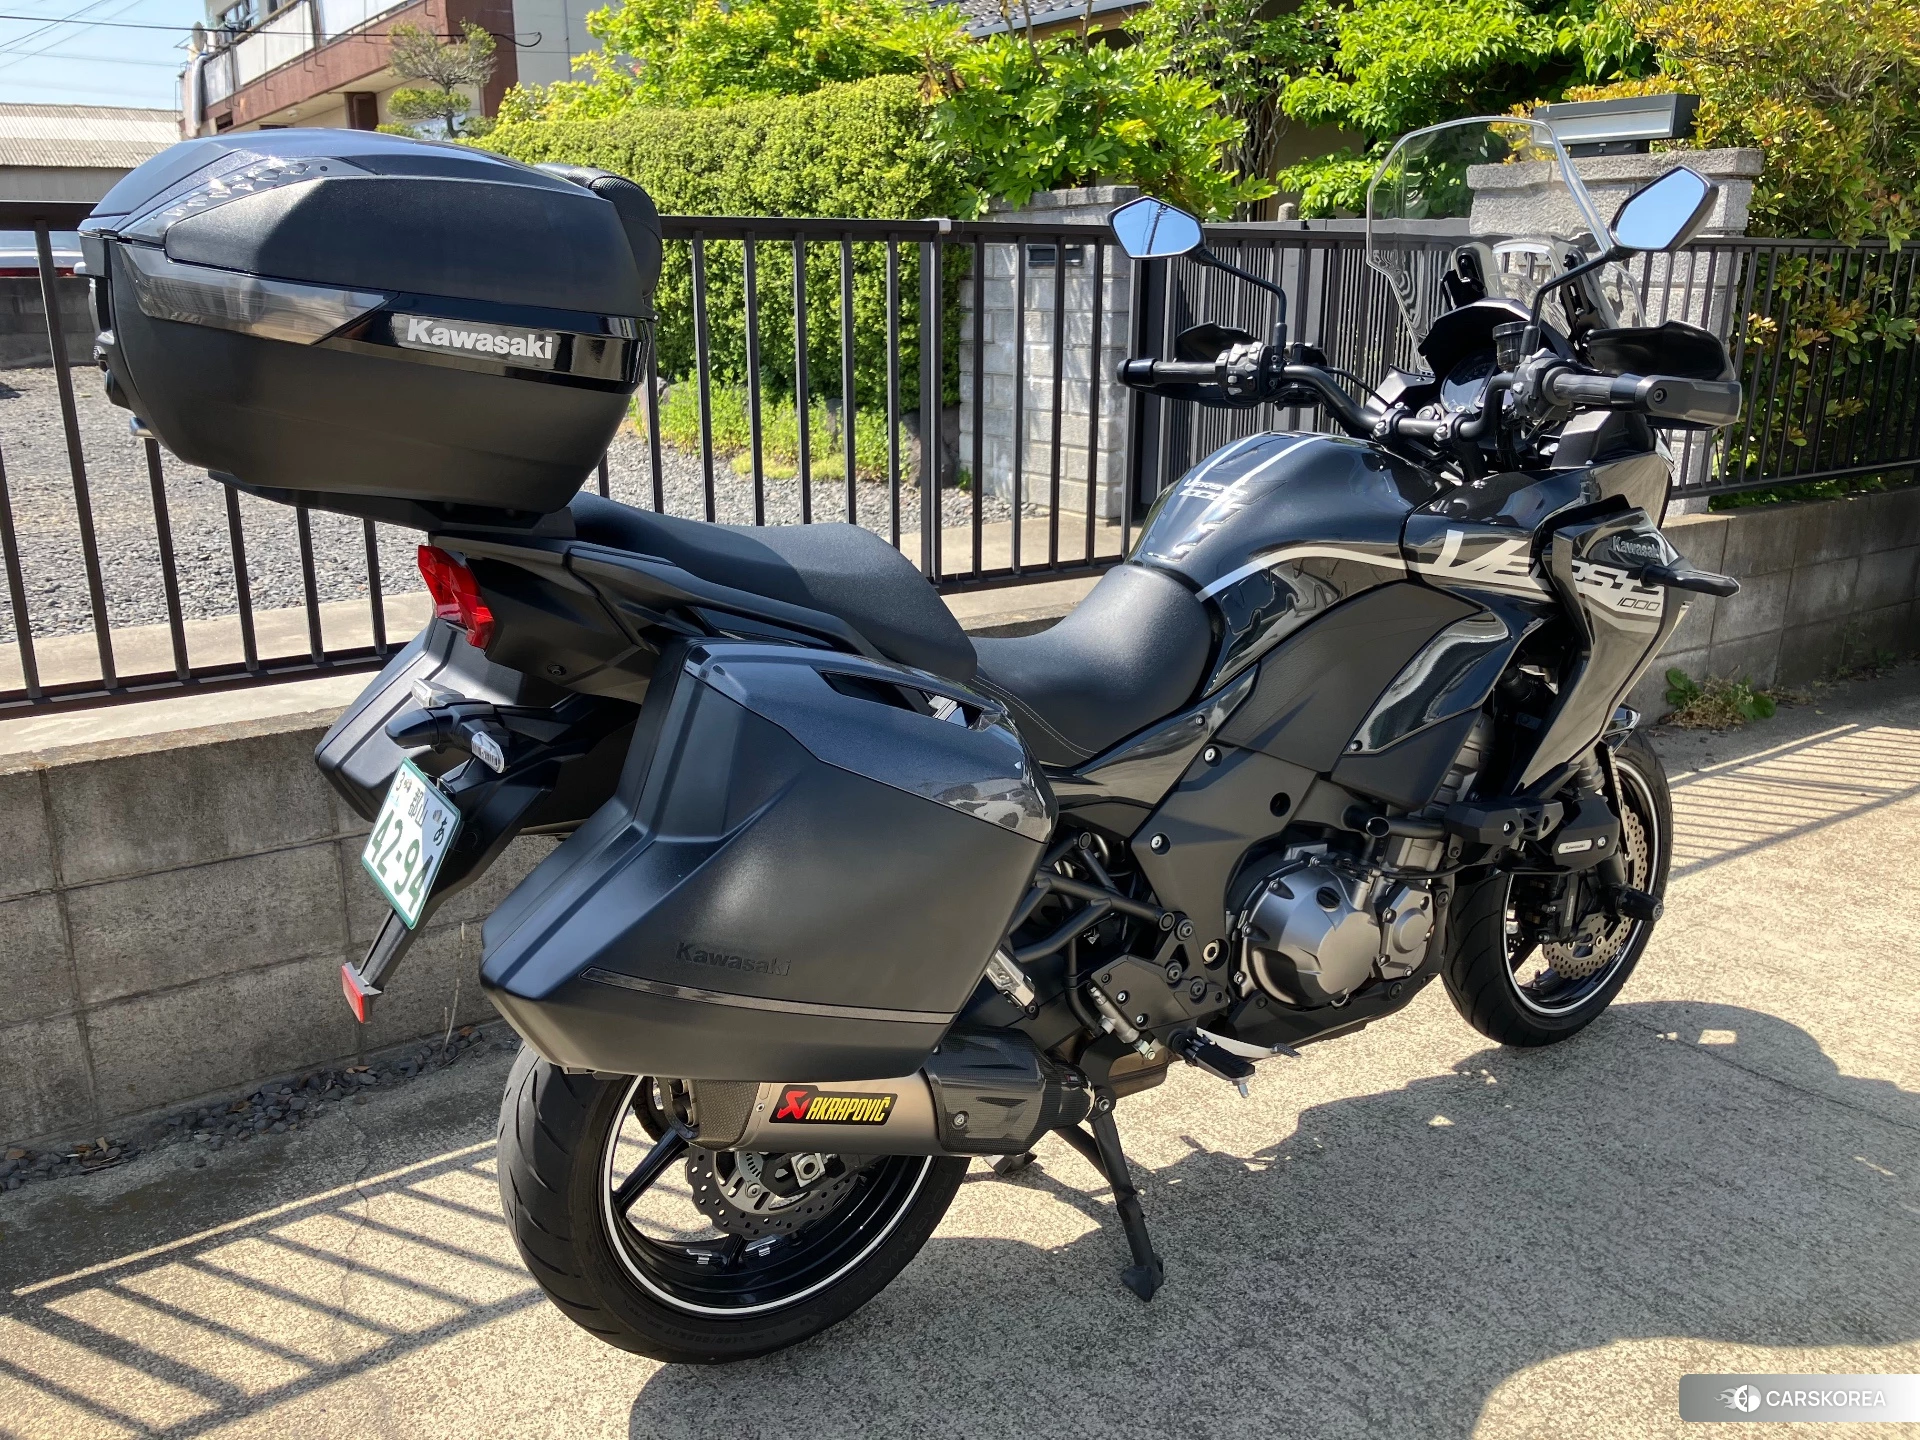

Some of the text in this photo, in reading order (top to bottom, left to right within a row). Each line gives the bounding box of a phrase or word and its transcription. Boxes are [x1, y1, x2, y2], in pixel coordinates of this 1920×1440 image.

[407, 318, 553, 359] Kawasaki
[1612, 535, 1661, 559] Kawasak
[1617, 597, 1661, 611] 1000
[407, 787, 448, 847] 郡山 あ
[371, 808, 434, 914] 42-94
[675, 942, 792, 976] Kawasaki
